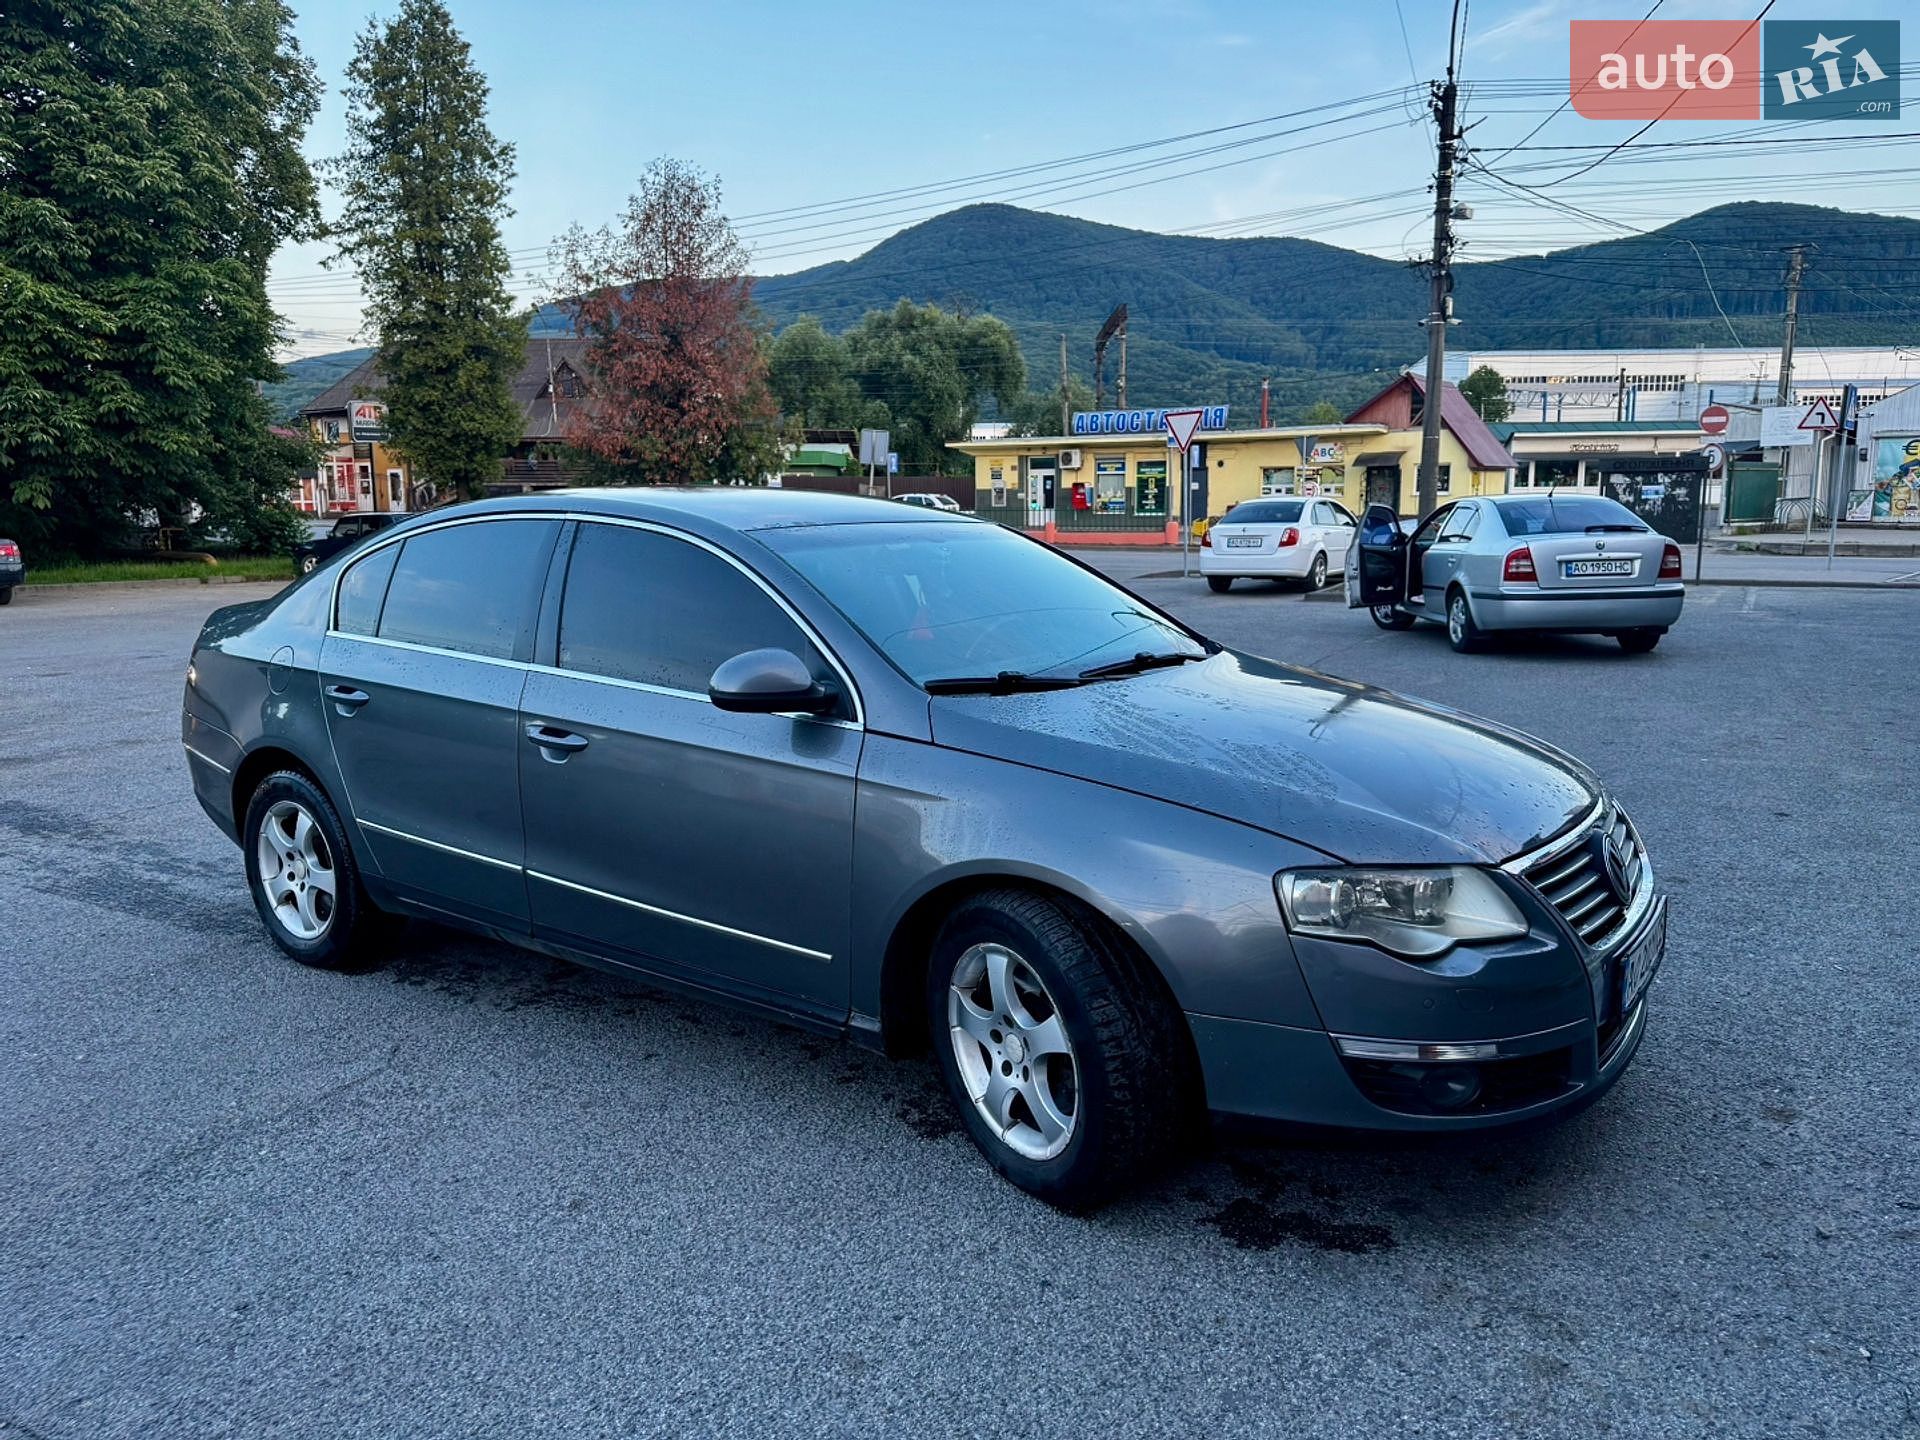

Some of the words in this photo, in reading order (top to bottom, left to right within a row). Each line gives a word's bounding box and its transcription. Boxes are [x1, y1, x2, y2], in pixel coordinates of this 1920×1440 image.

[1074, 407, 1225, 433] АВТОСТАІЯ
[1573, 562, 1588, 573] AO
[1590, 562, 1613, 572] 1950
[1614, 562, 1630, 572] HC
